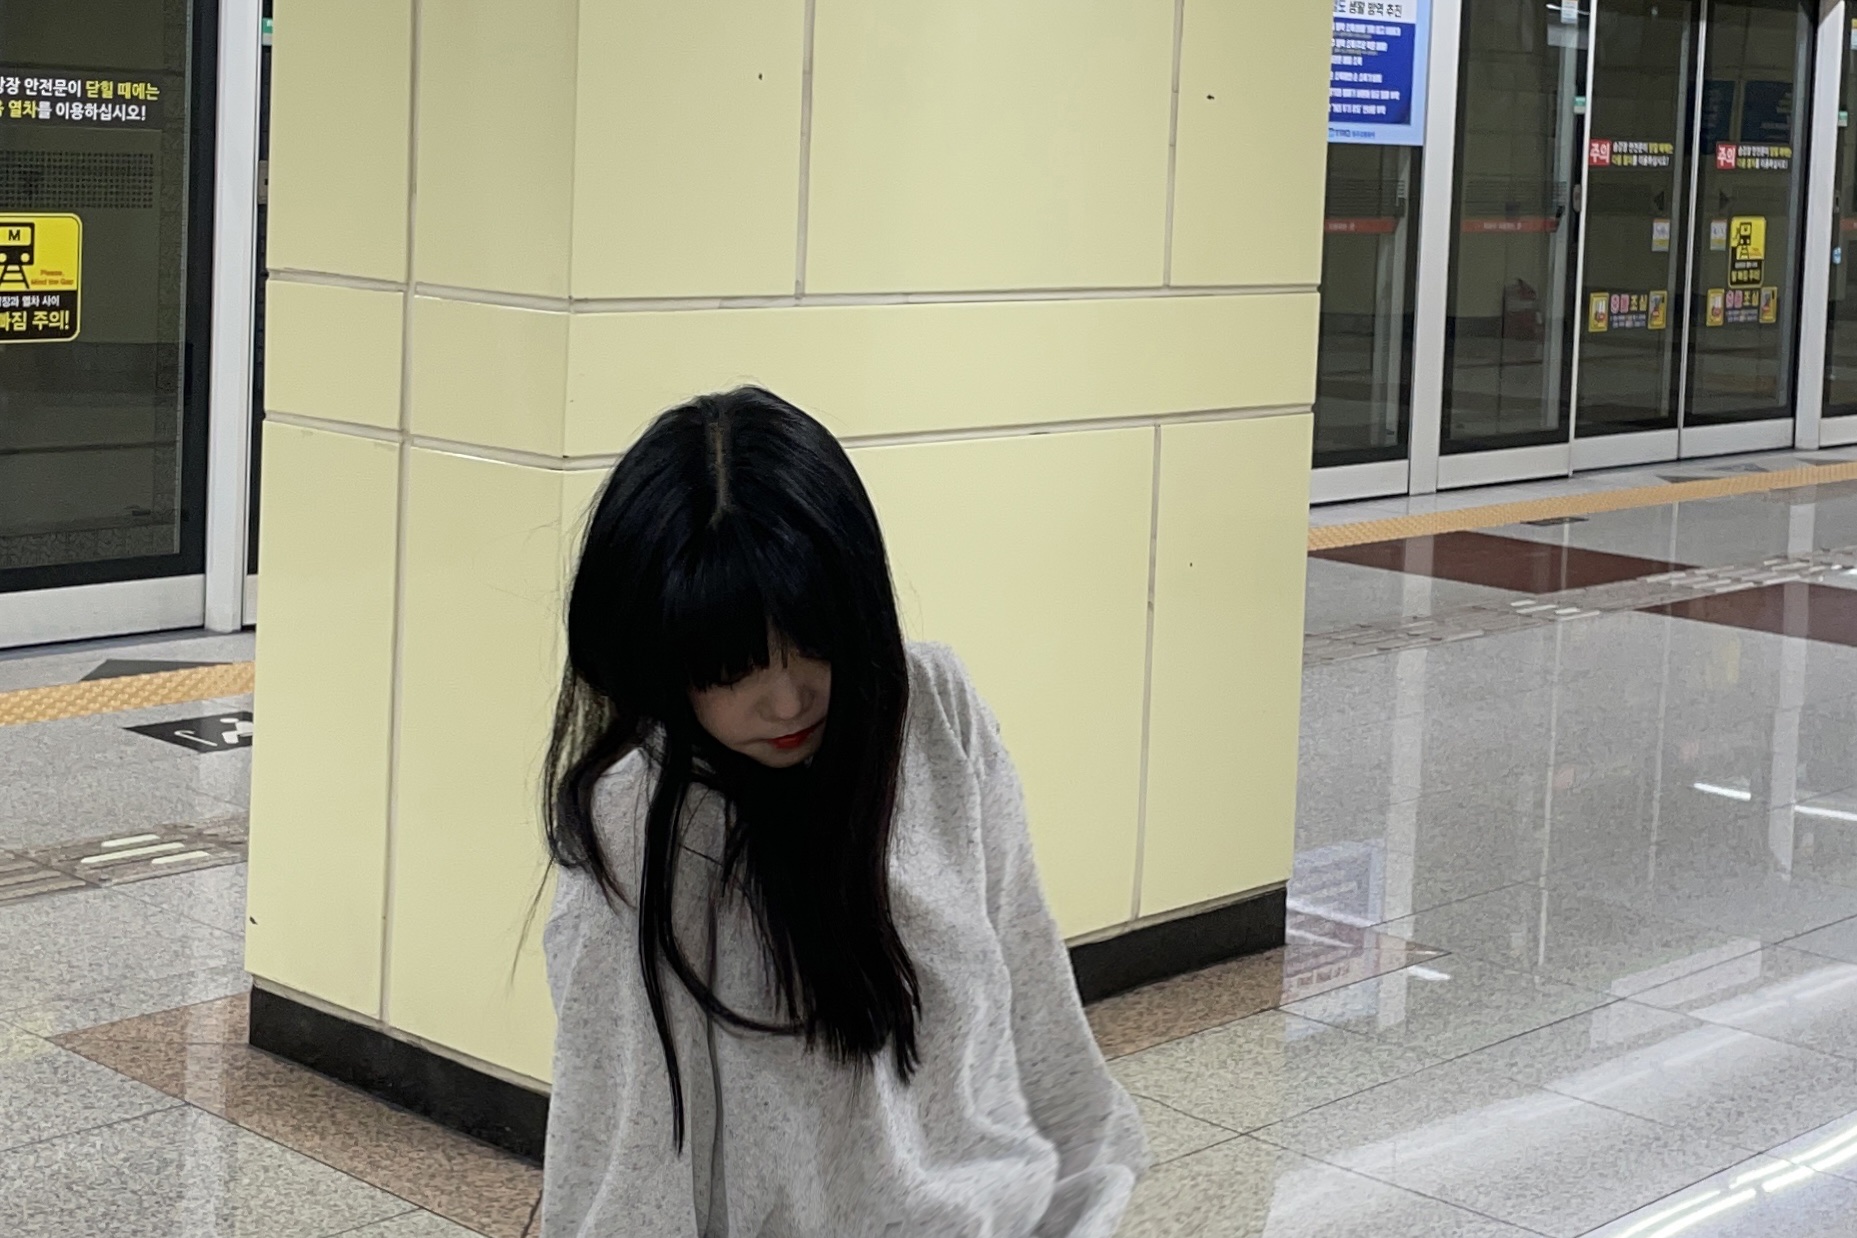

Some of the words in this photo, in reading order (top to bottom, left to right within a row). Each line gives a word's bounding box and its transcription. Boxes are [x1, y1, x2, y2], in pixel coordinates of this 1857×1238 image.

[1368, 2, 1384, 16] 방역
[1387, 4, 1402, 18] 추진
[24, 78, 82, 97] 안전문이
[85, 80, 113, 98] 닫힐
[117, 82, 160, 100] 때에는
[8, 100, 52, 119] 열차를
[55, 102, 146, 121] 이용하십시오!
[1590, 142, 1610, 164] 주의
[1717, 144, 1736, 167] 주의
[9, 229, 21, 241] M
[0, 295, 19, 307] 장과
[42, 295, 60, 307] 사이
[32, 310, 70, 331] 주의!
